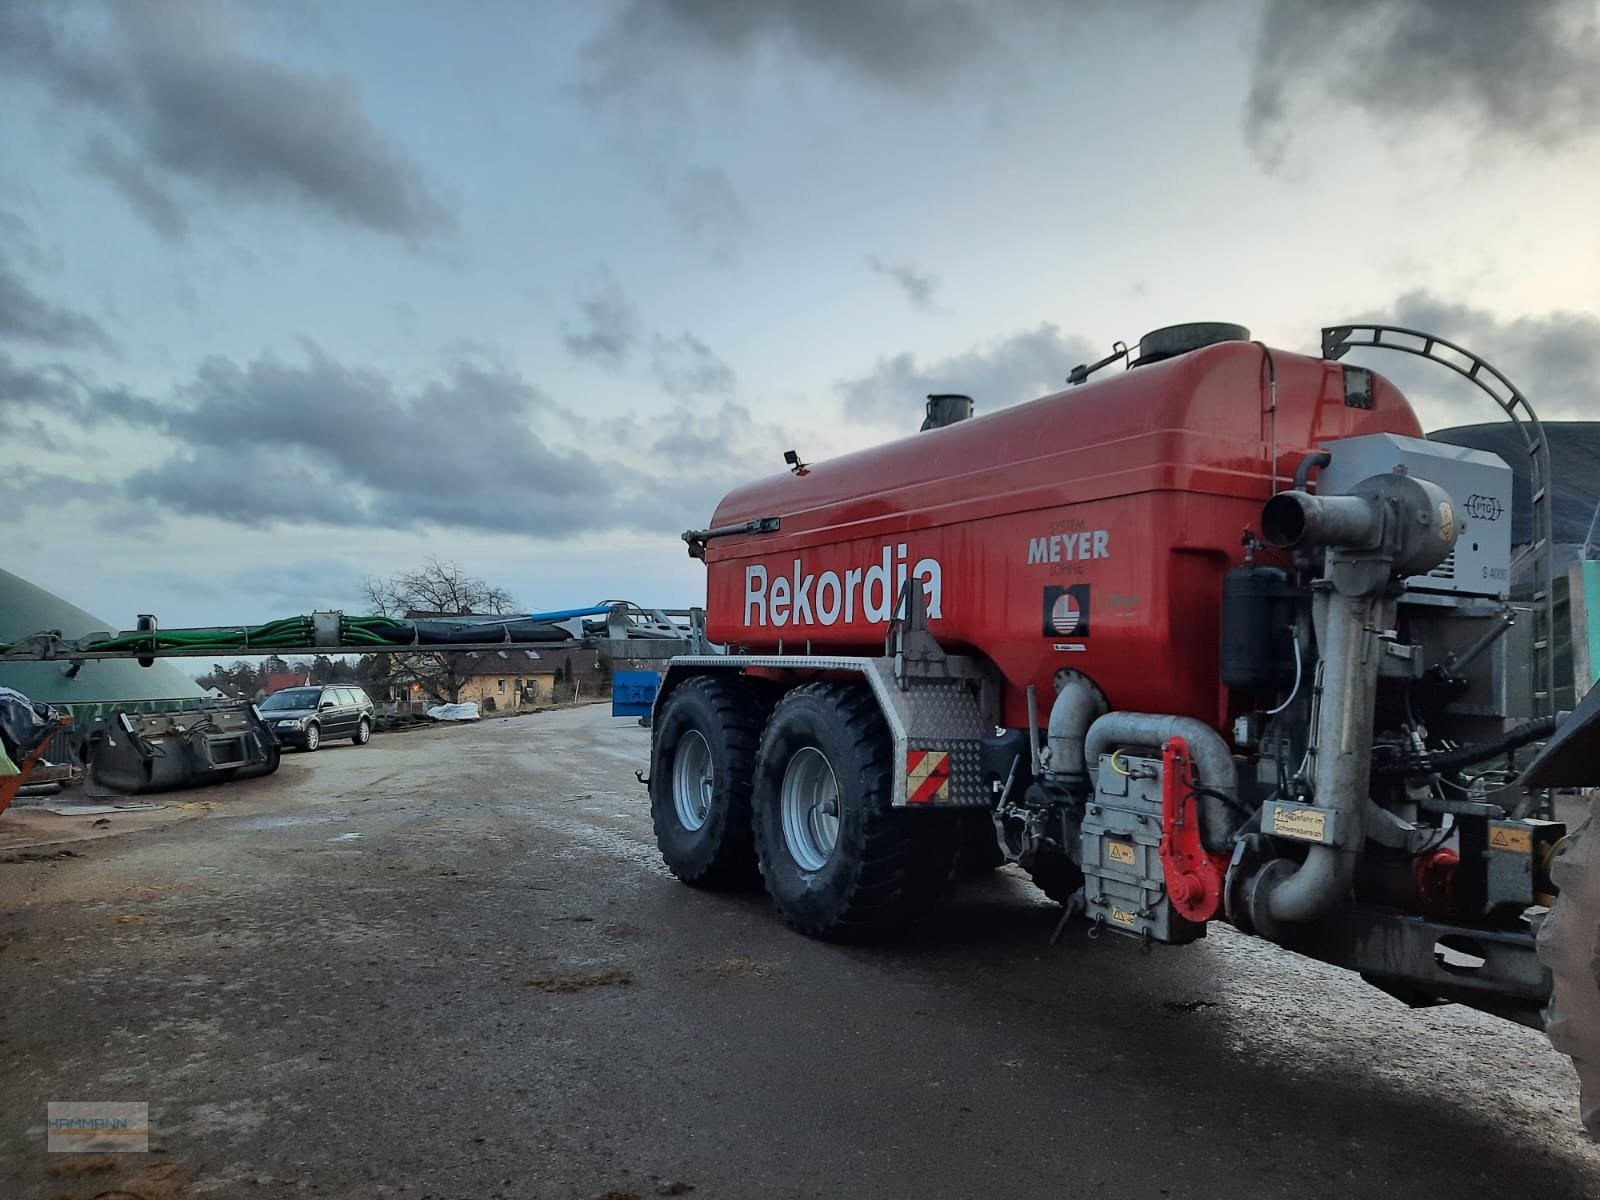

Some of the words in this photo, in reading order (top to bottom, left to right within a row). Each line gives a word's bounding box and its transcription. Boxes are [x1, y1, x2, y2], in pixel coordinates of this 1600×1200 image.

[1476, 502, 1492, 513] PTG
[1027, 530, 1109, 564] MEYER
[1482, 566, 1488, 579] S
[744, 543, 942, 627] Rekordia
